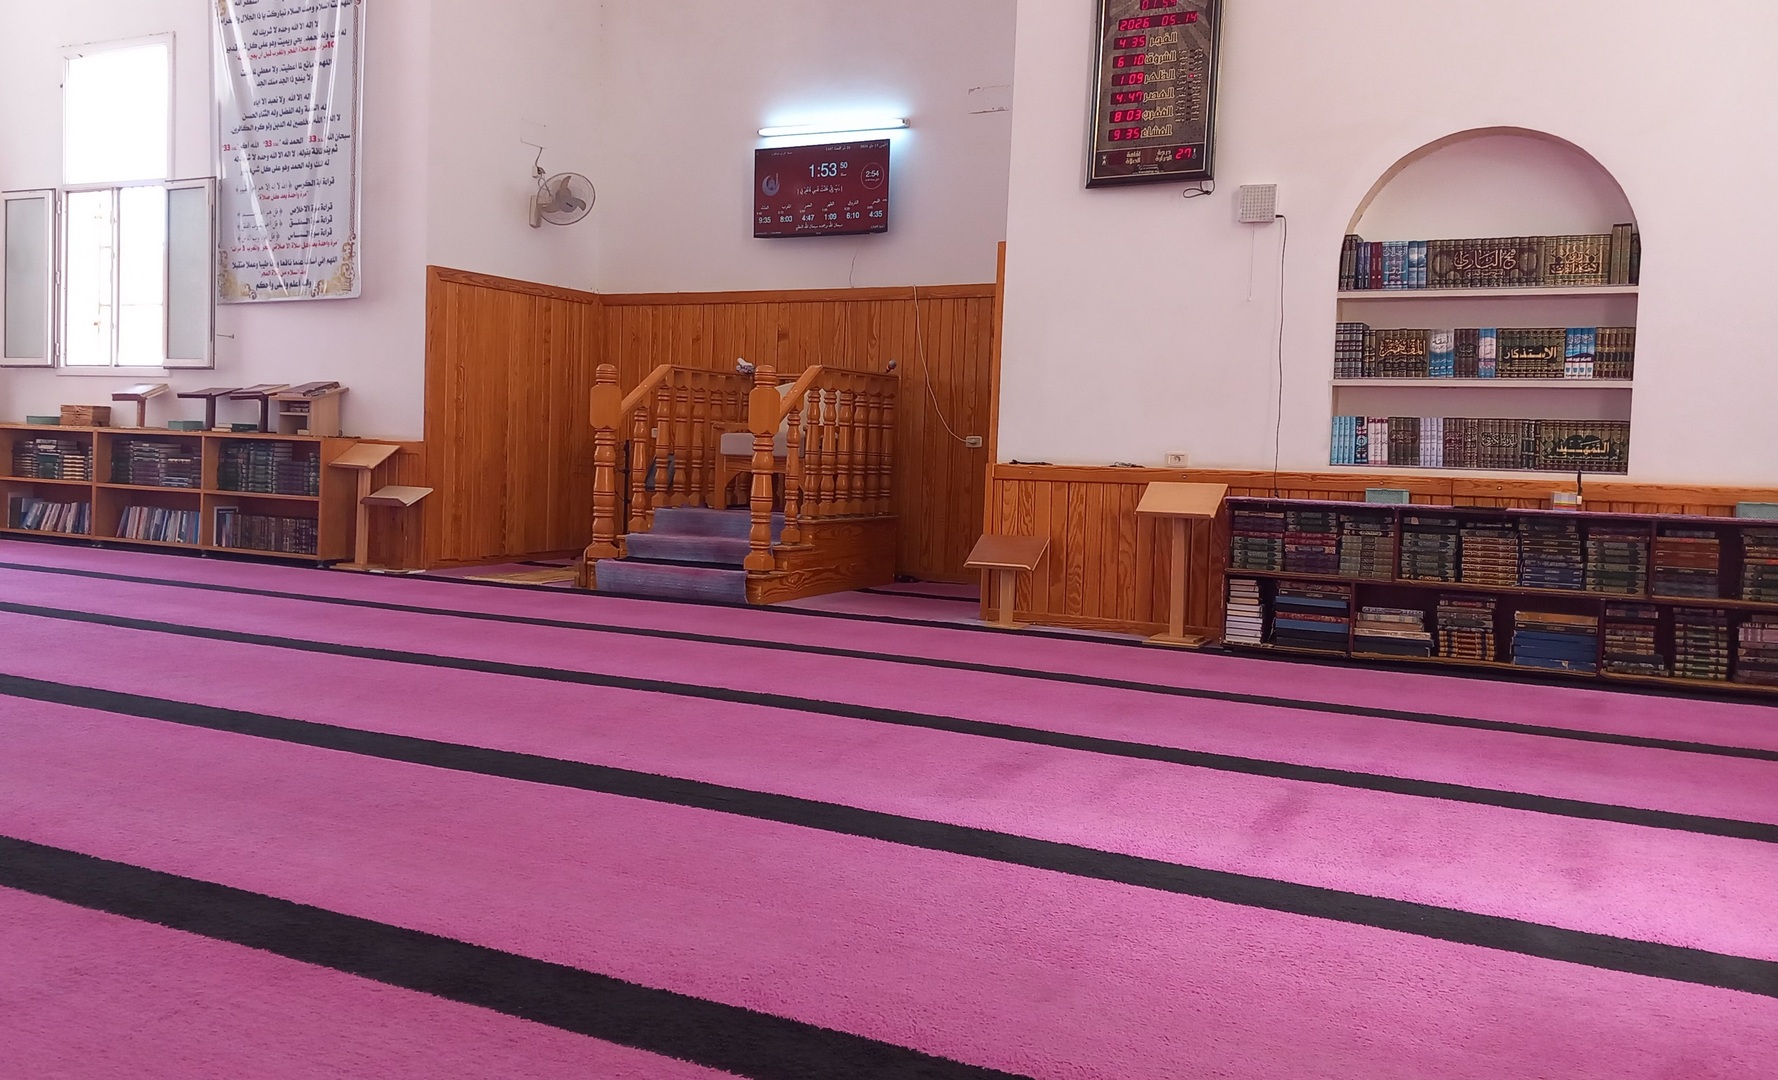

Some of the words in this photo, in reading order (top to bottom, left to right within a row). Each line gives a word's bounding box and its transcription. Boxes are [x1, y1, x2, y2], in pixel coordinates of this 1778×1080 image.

[1120, 18, 1149, 31] 2026
[1150, 32, 1178, 47] الفجر
[1145, 51, 1177, 65] الشروق
[1144, 69, 1176, 84] الظهر
[1144, 87, 1175, 102] العصر
[1142, 105, 1174, 121] المغرب
[1141, 124, 1173, 139] العشاء
[1175, 148, 1191, 160] 27
[809, 162, 837, 178] 1:53
[839, 161, 849, 170] 50
[865, 170, 880, 178] 2:54
[759, 216, 771, 224] 9:35
[780, 215, 793, 223] 8:03
[802, 214, 815, 222] 4:47
[824, 212, 837, 221] 1:09
[846, 211, 860, 219] 6:10
[869, 209, 883, 218] 4:35
[1453, 249, 1503, 270] الباري
[1503, 346, 1557, 360] الاستذكار
[1557, 439, 1610, 455] التمهيد
